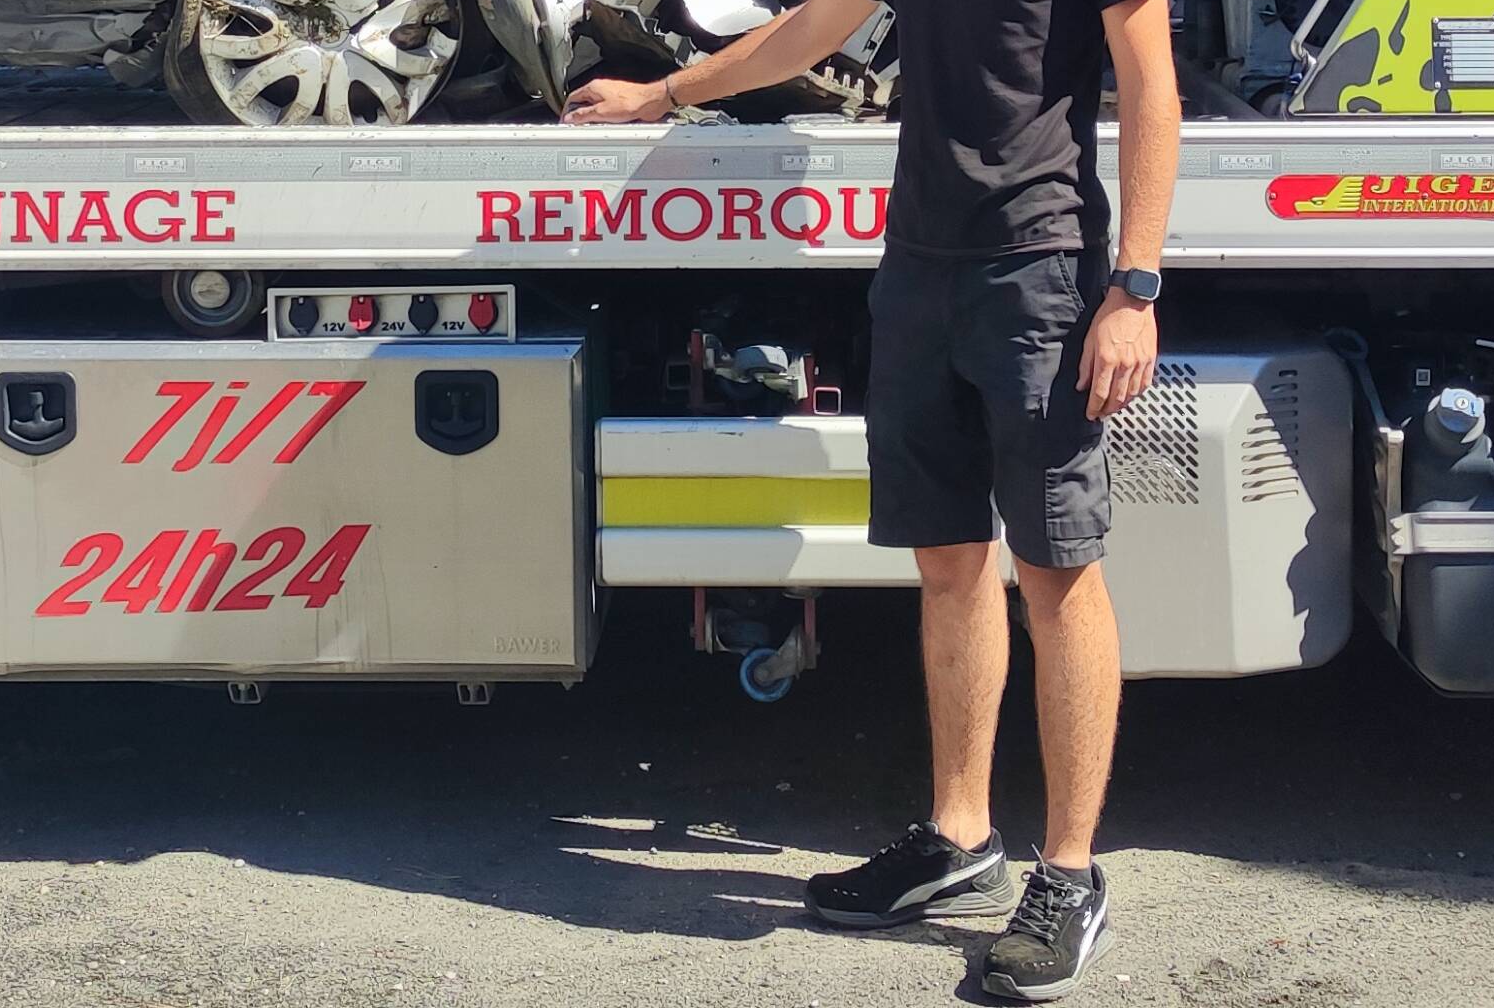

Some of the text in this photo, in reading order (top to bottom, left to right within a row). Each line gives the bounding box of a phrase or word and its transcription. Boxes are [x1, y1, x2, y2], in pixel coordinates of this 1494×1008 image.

[322, 322, 346, 332] 12V
[381, 321, 406, 332] 24V
[441, 321, 465, 331] 12V
[121, 380, 367, 472] 7j/7
[34, 523, 373, 617] 24h24
[493, 636, 561, 655] BAWER
